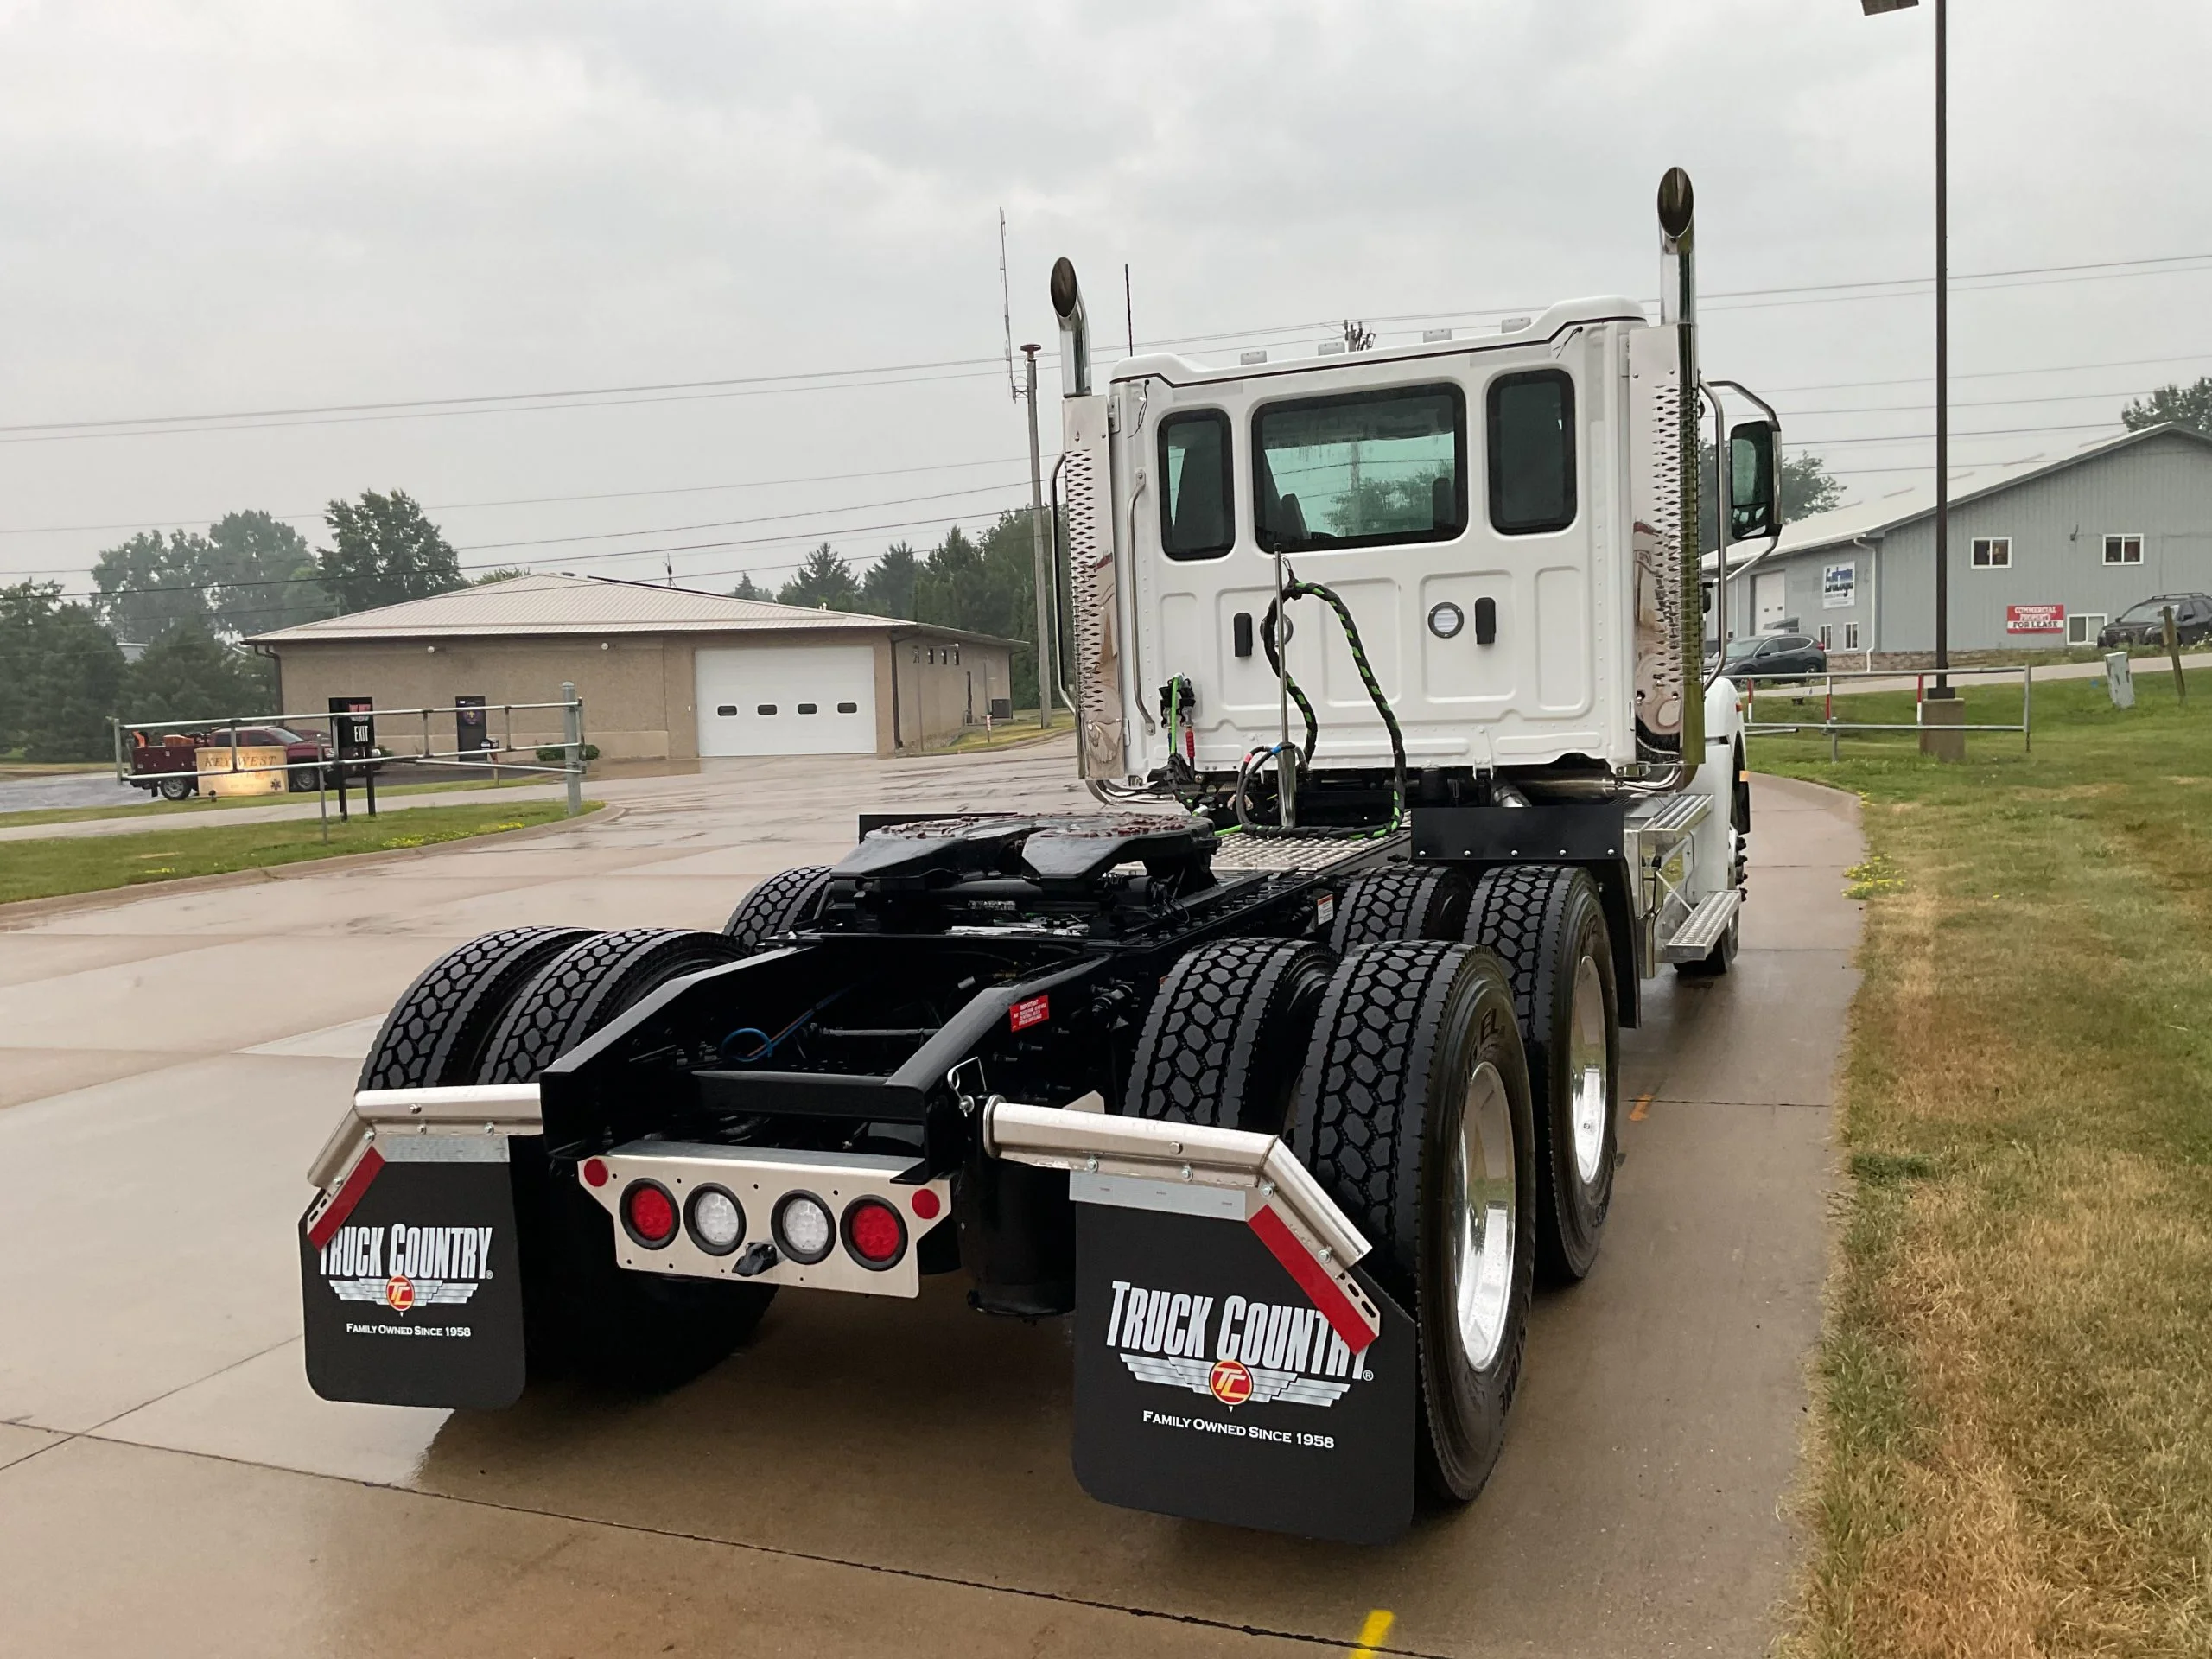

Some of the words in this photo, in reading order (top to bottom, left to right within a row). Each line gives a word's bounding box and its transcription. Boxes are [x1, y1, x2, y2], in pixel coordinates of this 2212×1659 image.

[353, 725, 369, 742] EXIT
[205, 757, 232, 767] KEY
[238, 755, 276, 766] WEST
[1106, 1280, 1214, 1359] TRUCK
[346, 1323, 378, 1334] FAMILY
[378, 1325, 413, 1336] OWNED
[414, 1325, 443, 1337] SINCE
[445, 1326, 472, 1338] 1958
[1142, 1410, 1192, 1428] FAMILY
[1192, 1418, 1247, 1437] OWNED
[1249, 1426, 1292, 1443] SINCE
[1295, 1433, 1335, 1449] 1958
